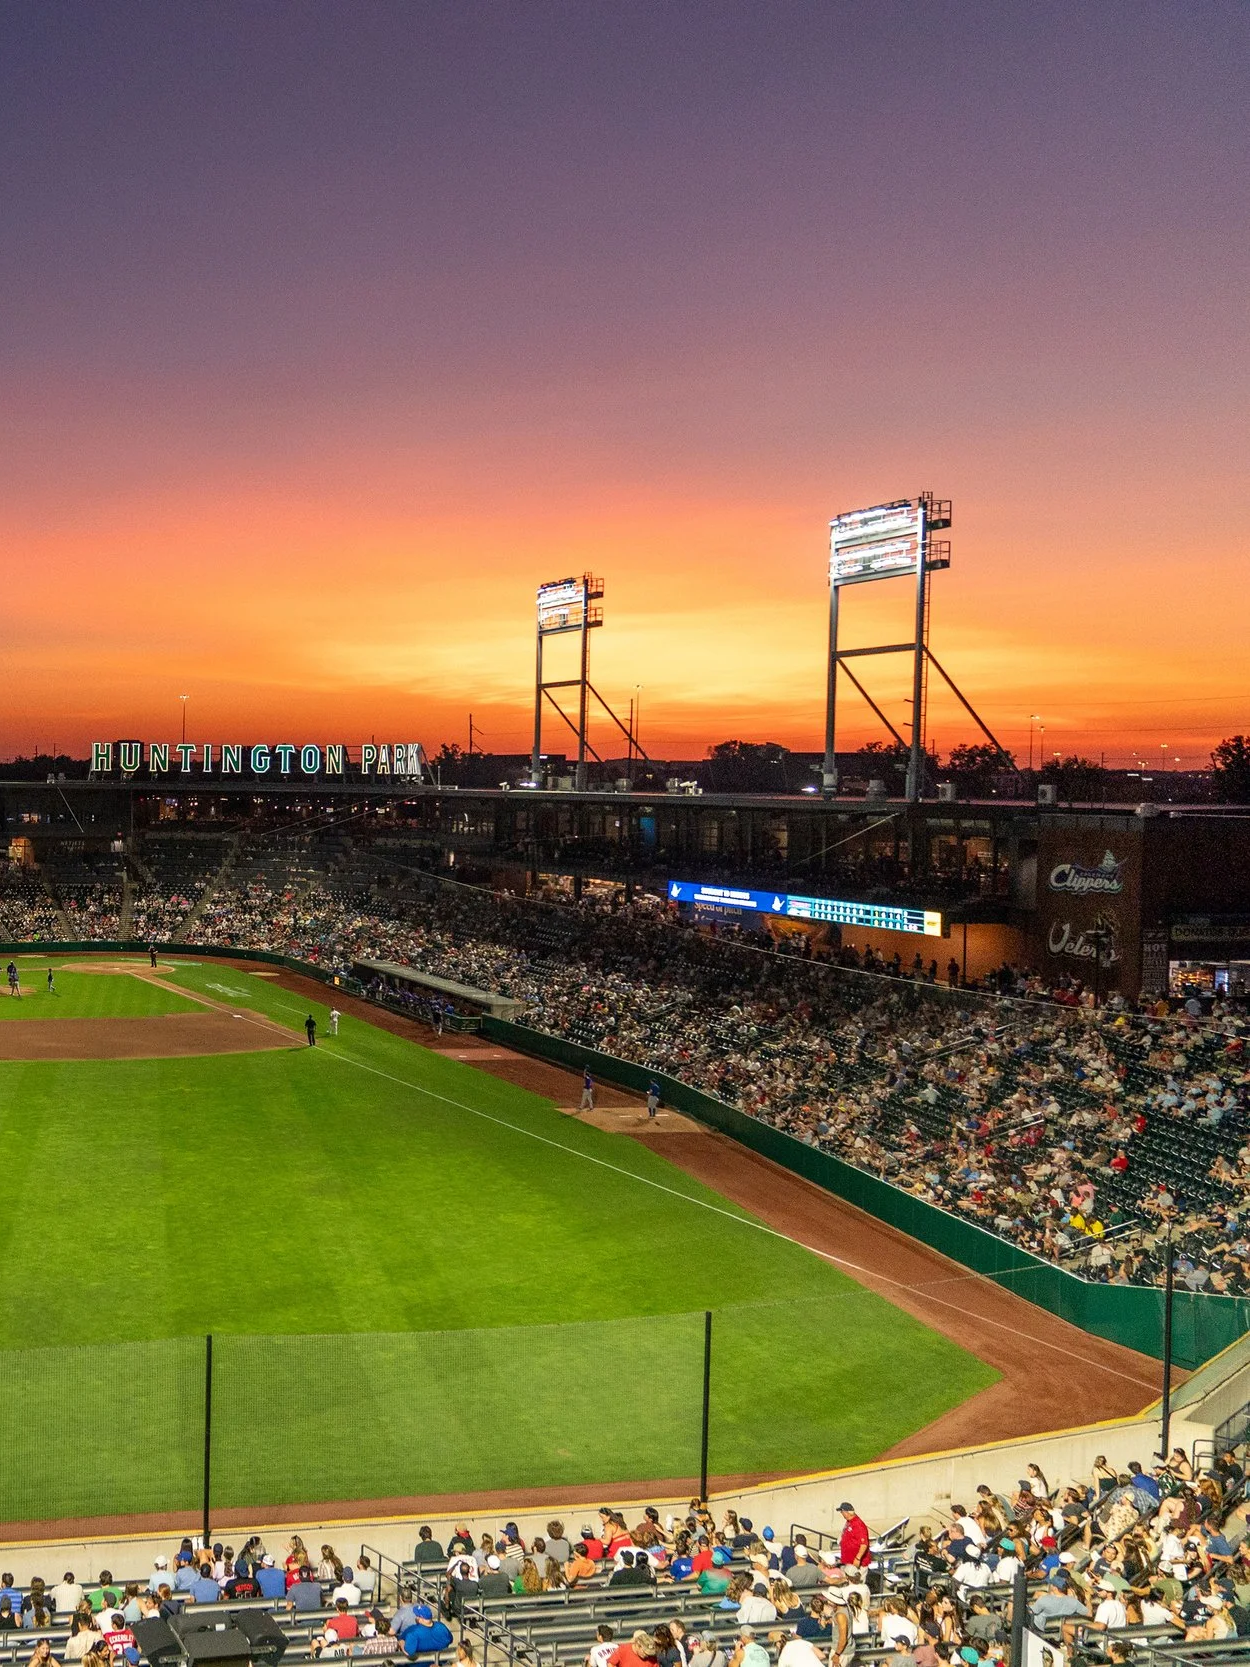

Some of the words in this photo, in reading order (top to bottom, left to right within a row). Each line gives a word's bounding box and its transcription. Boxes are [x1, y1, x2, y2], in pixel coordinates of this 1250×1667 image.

[92, 742, 344, 775] HUNTINGTON
[361, 743, 422, 775] PARK
[1050, 864, 1123, 893] Clippers
